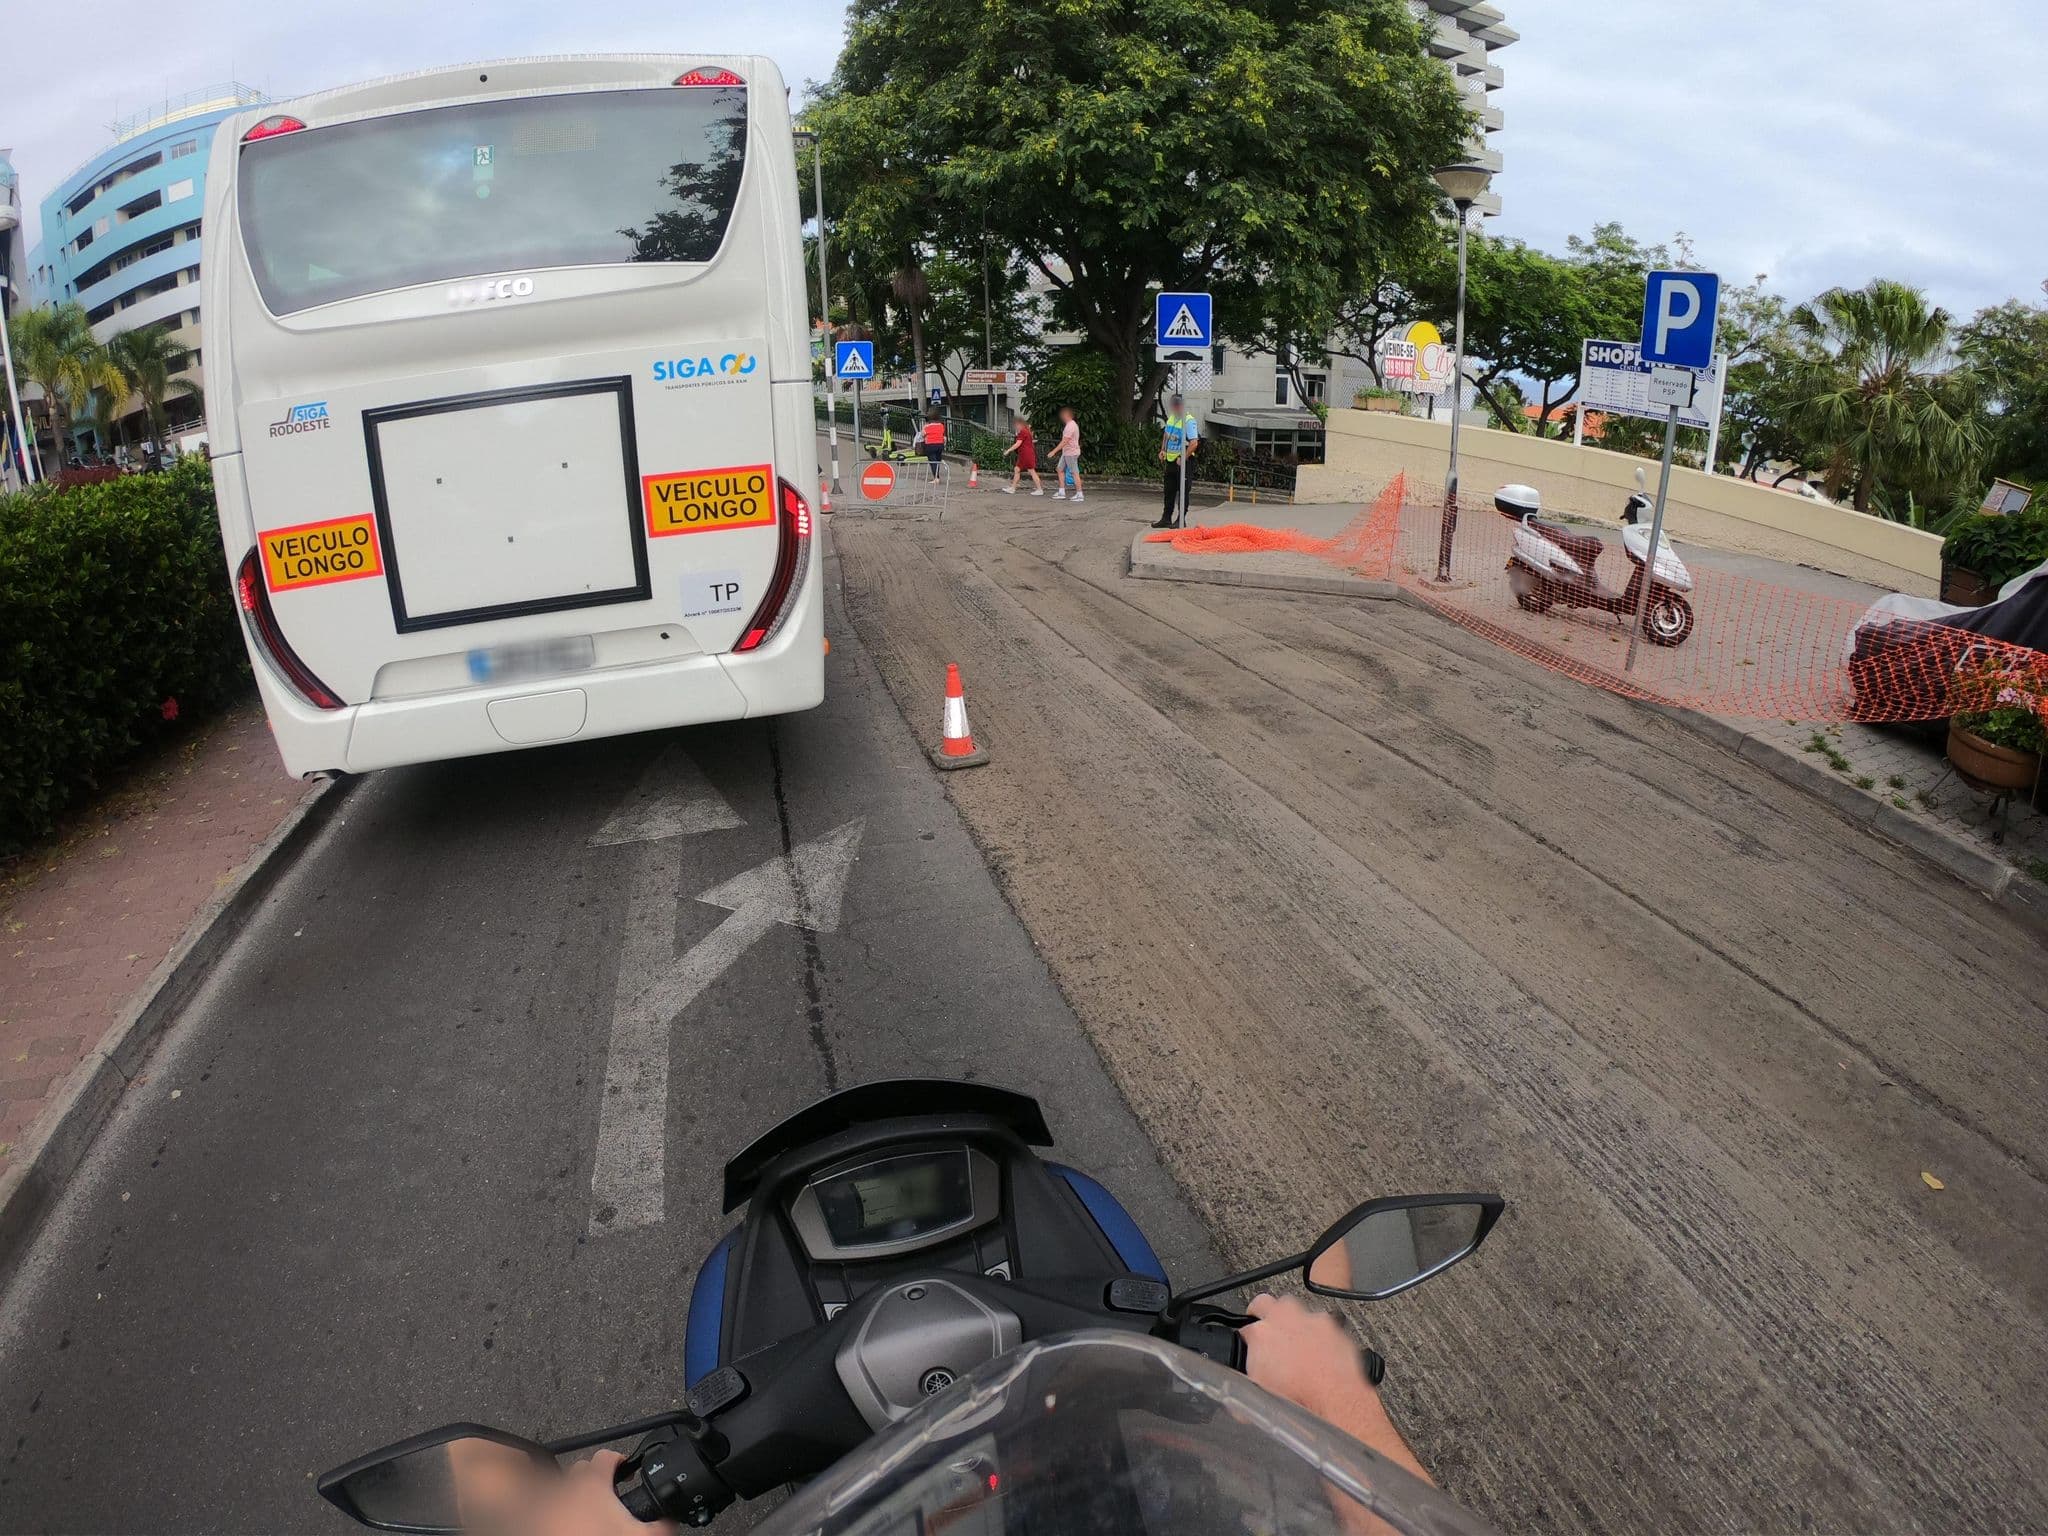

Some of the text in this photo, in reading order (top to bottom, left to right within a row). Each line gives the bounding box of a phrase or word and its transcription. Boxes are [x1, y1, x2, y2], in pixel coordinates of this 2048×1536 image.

[1655, 280, 1700, 355] P
[1385, 342, 1413, 358] VENDE-SE
[653, 357, 715, 381] SIGA
[1653, 377, 1687, 389] Reservado
[1662, 388, 1676, 396] PSP
[297, 406, 328, 422] SIGA
[269, 418, 331, 438] RODOESTE
[656, 475, 765, 503] VEICULO
[669, 497, 757, 524] LONGO
[271, 526, 369, 559] VEICULO
[284, 550, 364, 580] LONGO
[709, 582, 740, 602] TP
